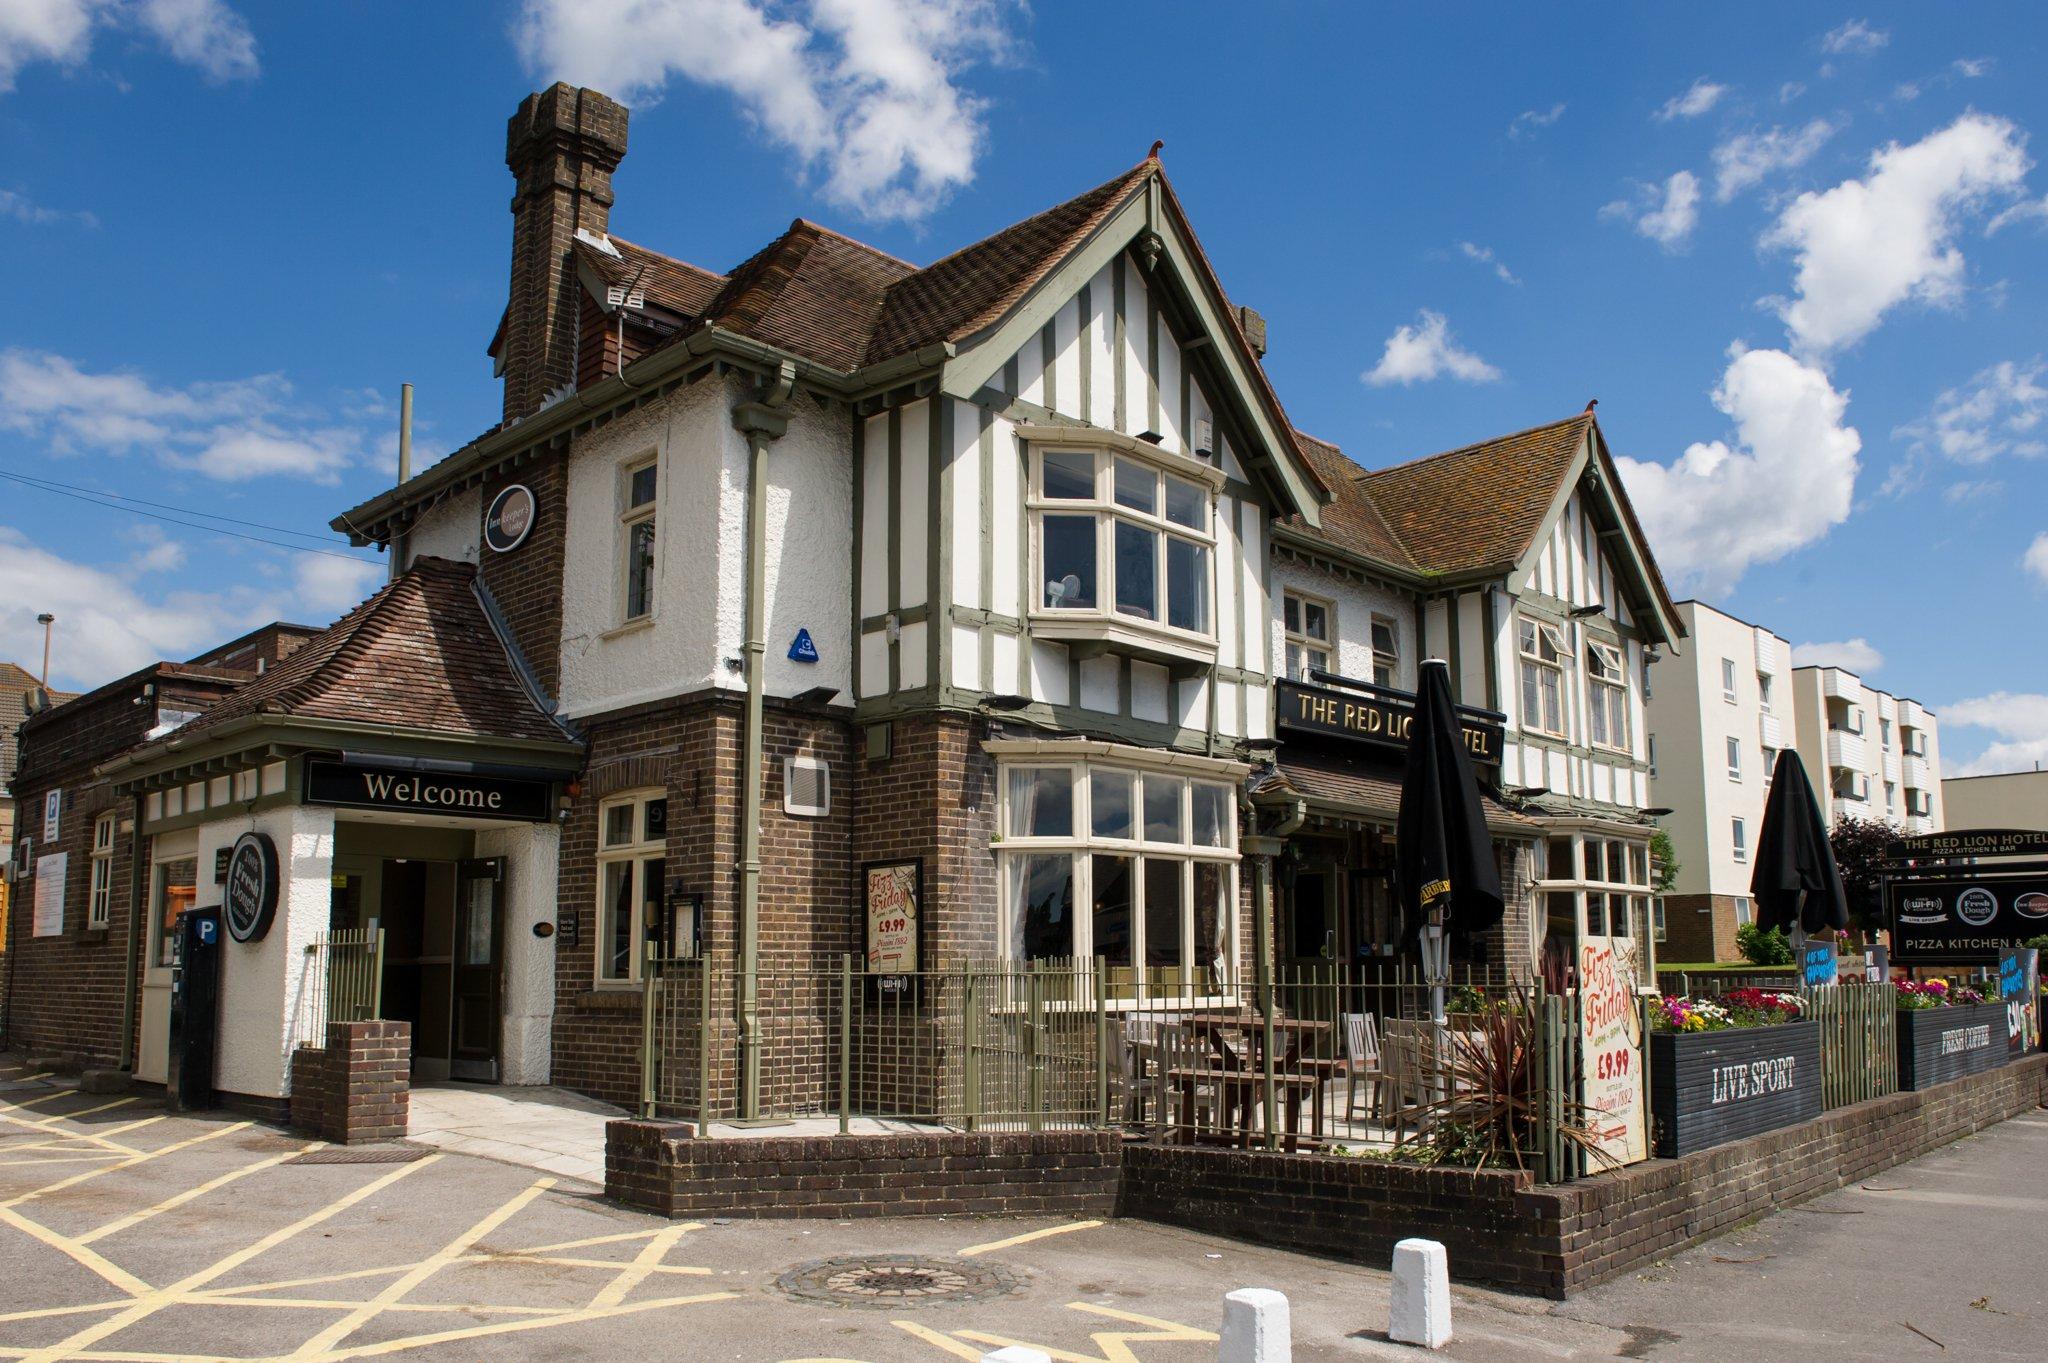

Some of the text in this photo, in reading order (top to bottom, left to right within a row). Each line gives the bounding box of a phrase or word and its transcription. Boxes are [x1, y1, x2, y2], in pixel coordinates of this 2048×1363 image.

[1298, 694, 1338, 725] THE
[1344, 704, 1381, 732] RED
[362, 773, 501, 808] Welcome
[1904, 833, 2048, 850] THE RED LION HOTEL
[1956, 846, 1992, 854] KITCHEN
[236, 861, 259, 897] Fresh
[870, 873, 892, 893] Fizz
[232, 879, 256, 916] Dough
[871, 887, 906, 914] Friday
[1911, 900, 1935, 908] WI-FI
[1964, 899, 1991, 908] Fresh
[879, 918, 905, 932] £9.99
[1964, 907, 1991, 916] Dough
[201, 921, 214, 939] P
[1906, 938, 2023, 949] PIZZA KITCHEN &
[1582, 946, 1611, 992] Fizz
[1585, 978, 1629, 1037] Friday
[1941, 1024, 1990, 1055] FRESH COFFEE
[1598, 1048, 1629, 1080] £9.99
[1712, 1056, 1795, 1103] LIVE SPORT
